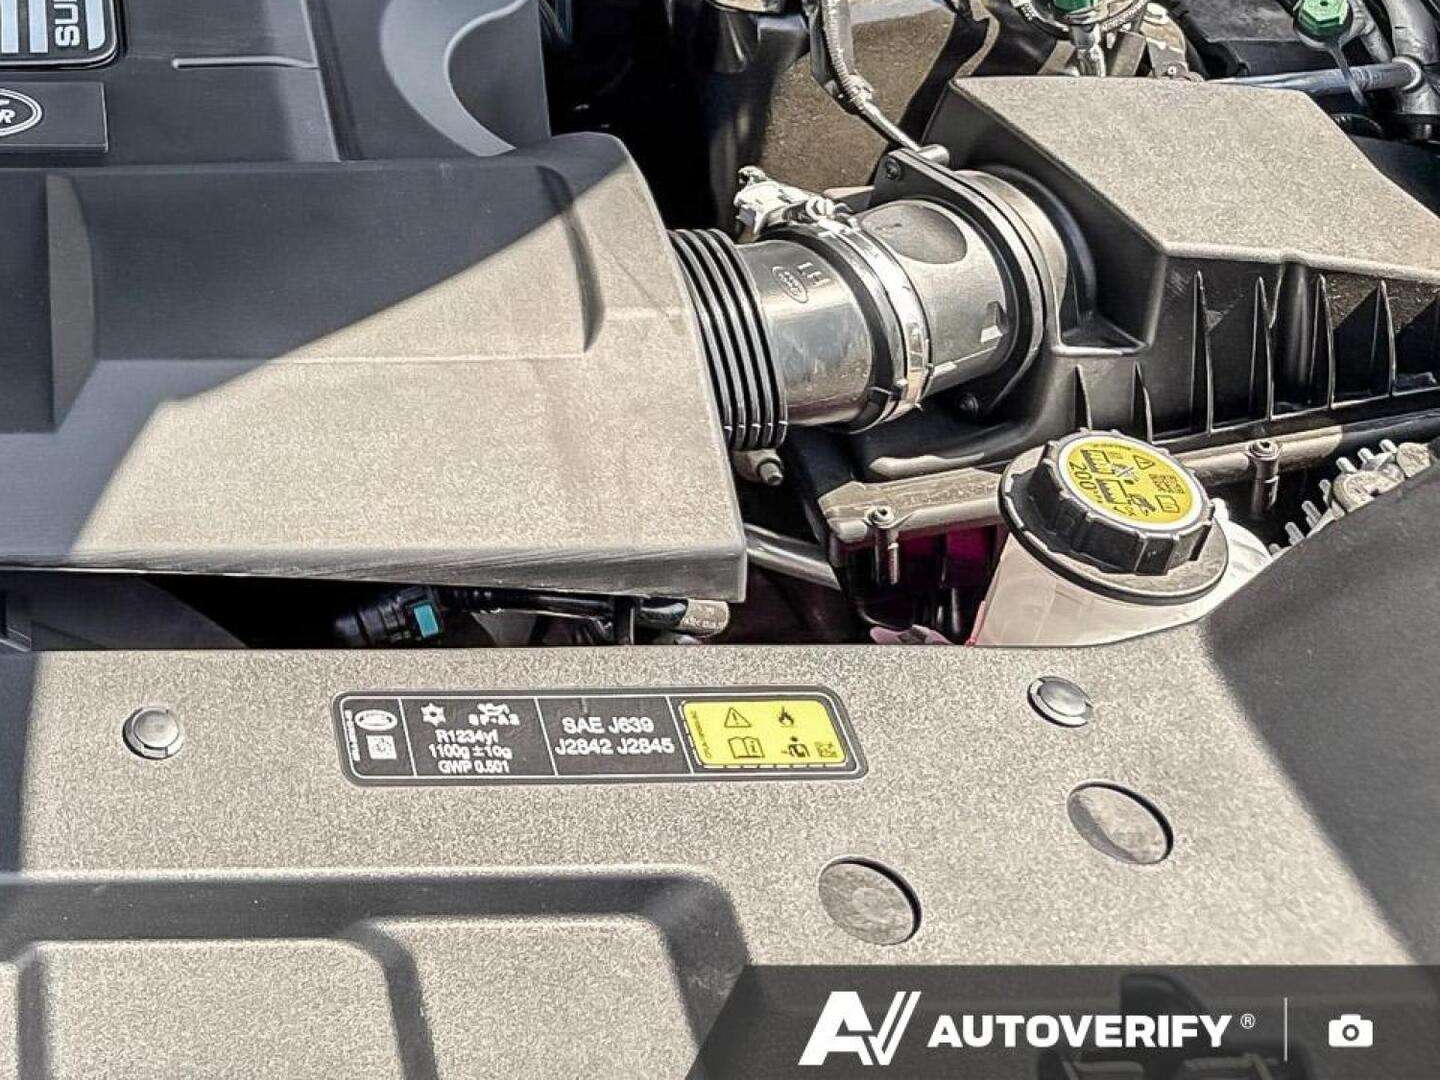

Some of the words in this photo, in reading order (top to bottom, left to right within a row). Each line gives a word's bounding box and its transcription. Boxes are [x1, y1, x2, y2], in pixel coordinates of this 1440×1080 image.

[562, 716, 606, 734] SAE
[608, 716, 655, 734] J639
[429, 744, 470, 759] 1100g
[554, 738, 614, 755] J2842
[616, 737, 675, 755] J2845
[438, 760, 472, 774] GWP
